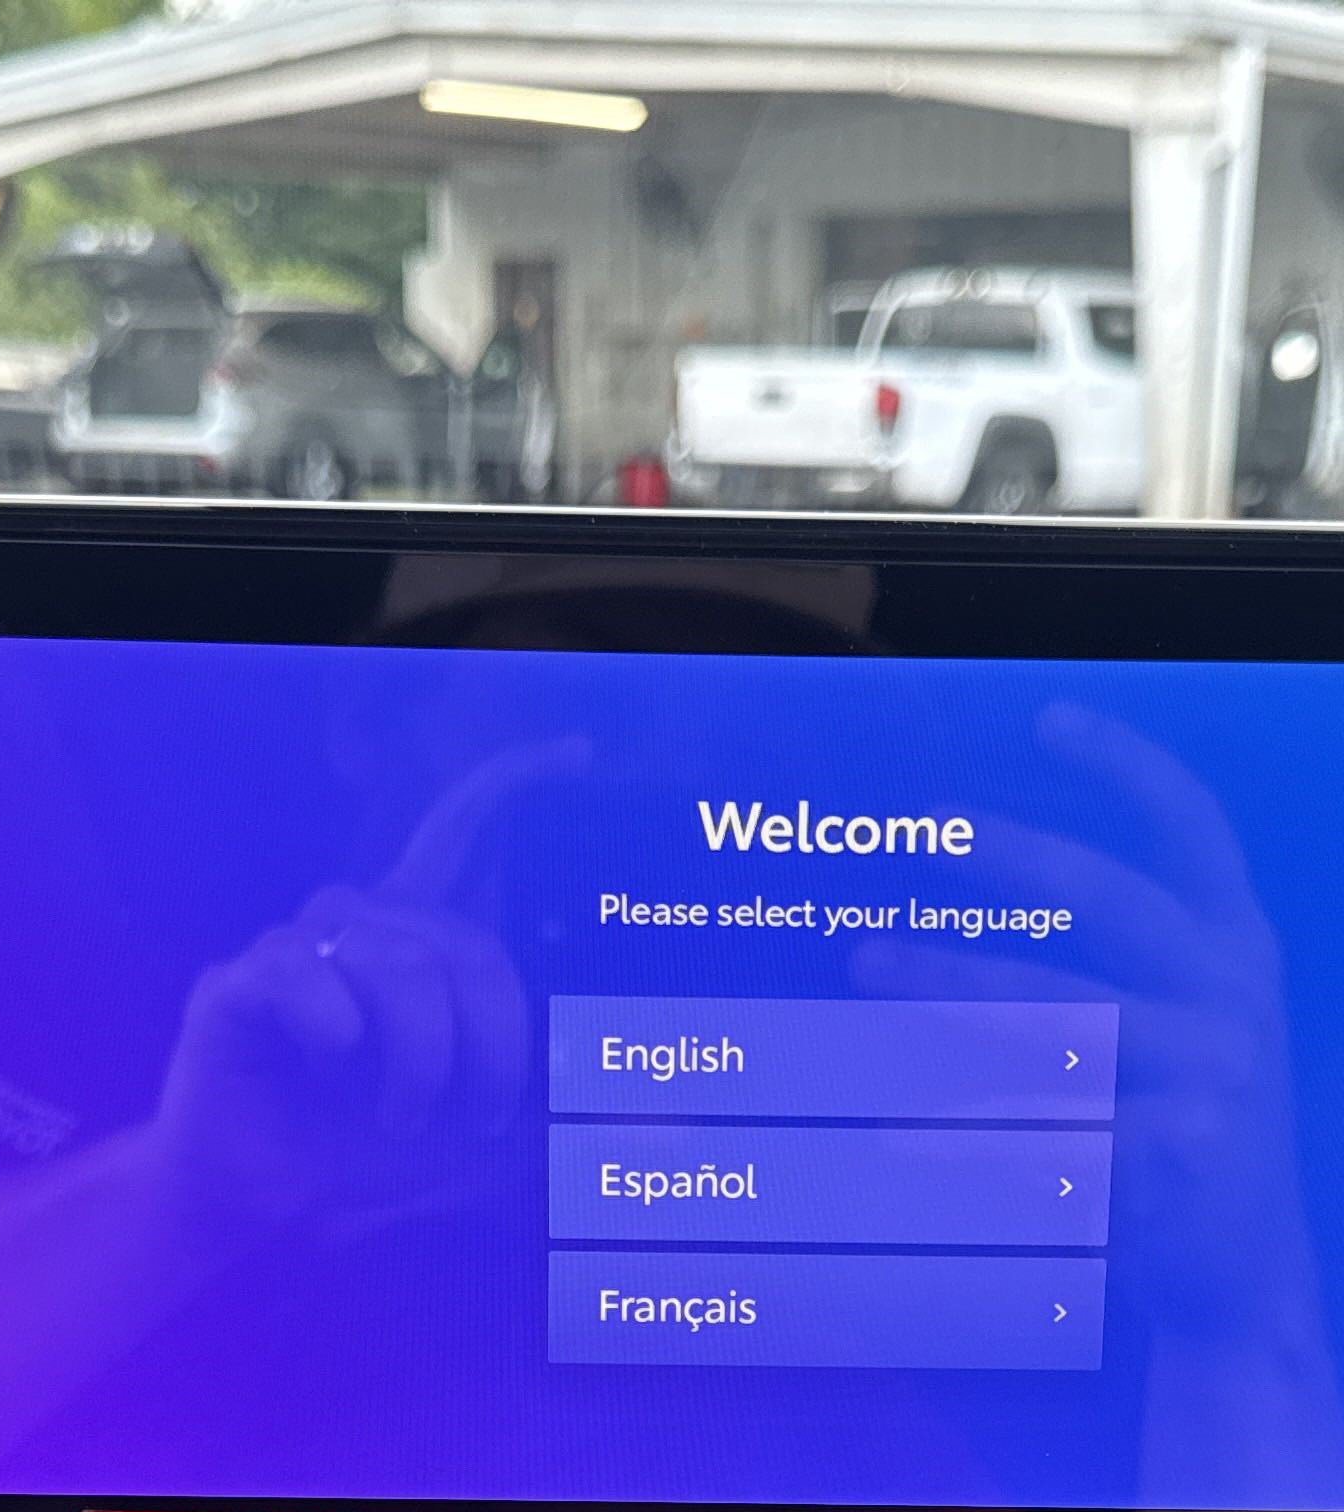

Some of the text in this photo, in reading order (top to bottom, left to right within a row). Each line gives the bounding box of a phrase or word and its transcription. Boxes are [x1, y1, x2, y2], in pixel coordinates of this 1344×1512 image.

[698, 800, 974, 855] Welcome
[600, 894, 1072, 938] Please select your language
[602, 1036, 744, 1081] English
[601, 1163, 757, 1205] Español
[599, 1290, 757, 1332] Français
